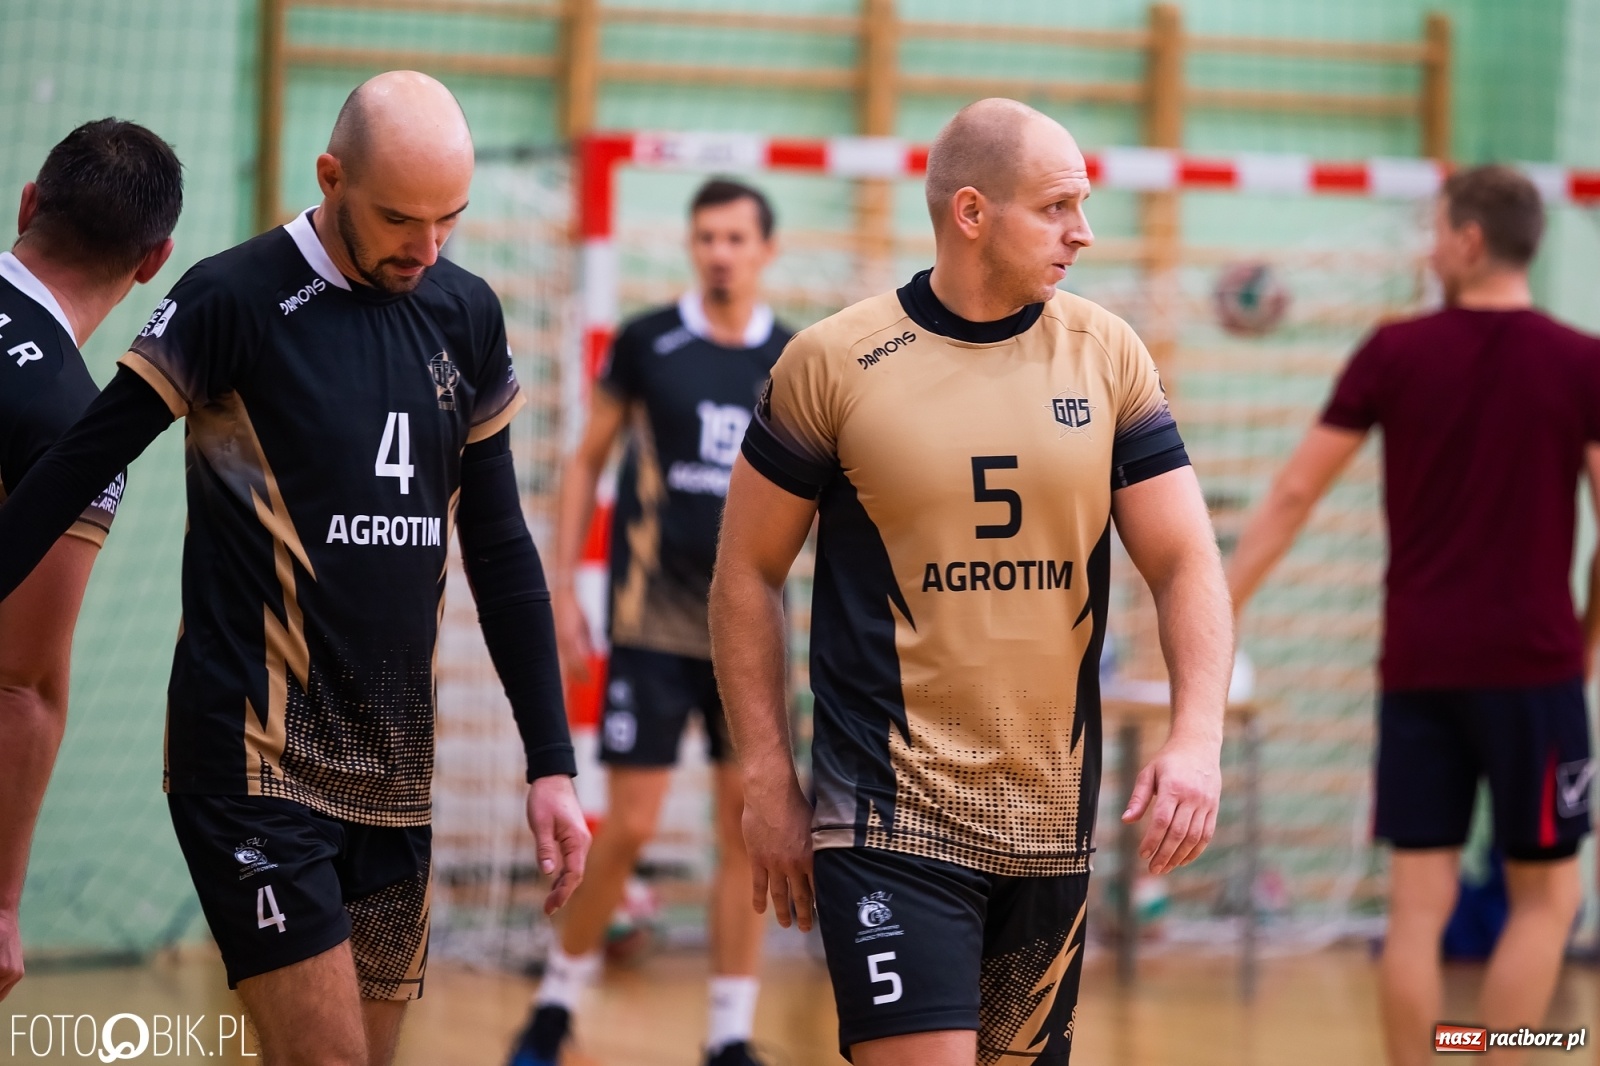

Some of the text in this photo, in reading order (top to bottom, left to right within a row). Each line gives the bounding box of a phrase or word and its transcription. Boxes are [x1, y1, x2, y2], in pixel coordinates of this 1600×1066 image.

[856, 331, 917, 370] DAMONS
[697, 401, 751, 467] 19
[1052, 398, 1091, 428] GAS
[374, 411, 415, 495] 4
[971, 455, 1023, 540] 5
[326, 514, 441, 547] AGROTIM
[921, 560, 1074, 593] AGROTIM
[256, 884, 287, 933] 4
[867, 951, 903, 1005] 5
